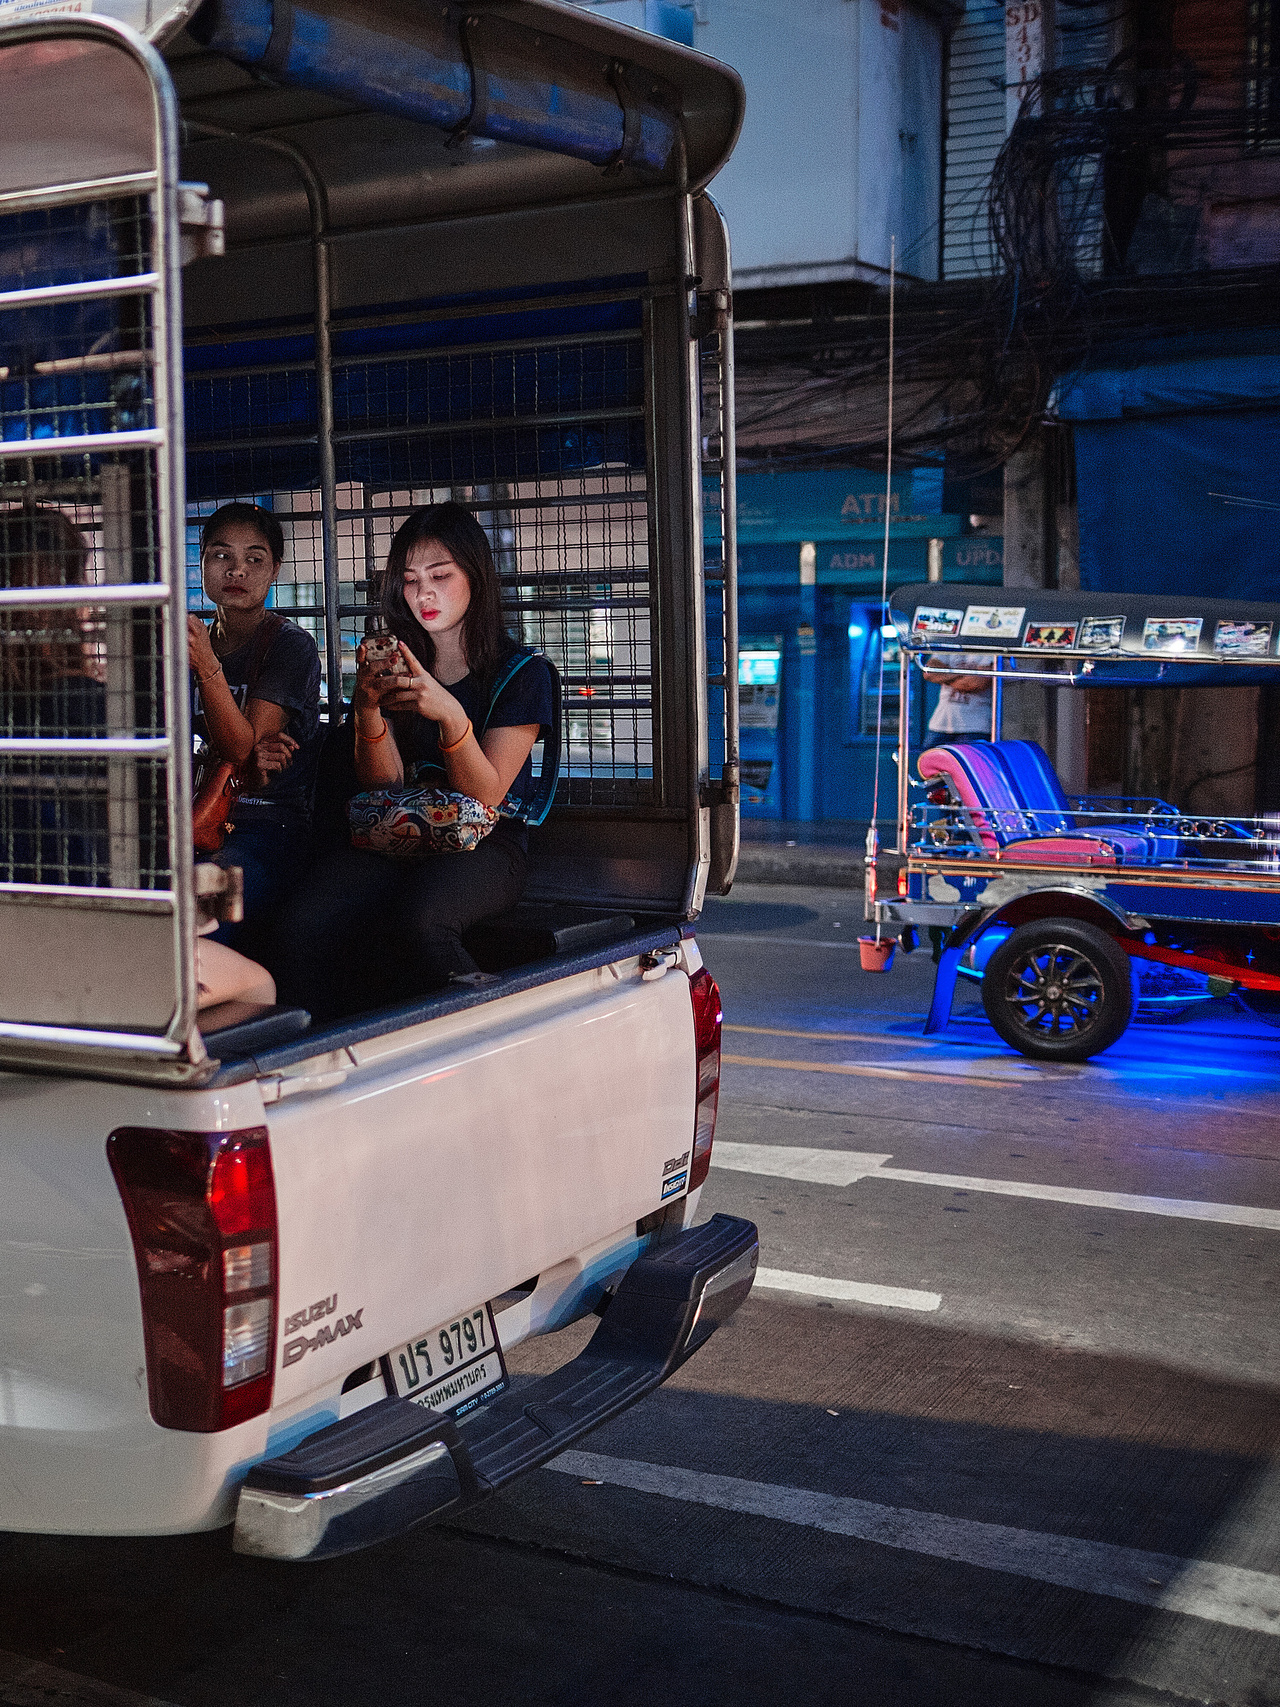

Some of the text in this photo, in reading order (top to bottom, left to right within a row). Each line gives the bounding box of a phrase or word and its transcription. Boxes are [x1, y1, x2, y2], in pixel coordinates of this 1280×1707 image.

[841, 493, 900, 515] ATM
[956, 550, 1004, 567] UPD
[283, 1293, 338, 1337] ISUZU
[282, 1307, 364, 1369] D-MAX
[399, 1309, 486, 1389] ปร 9797
